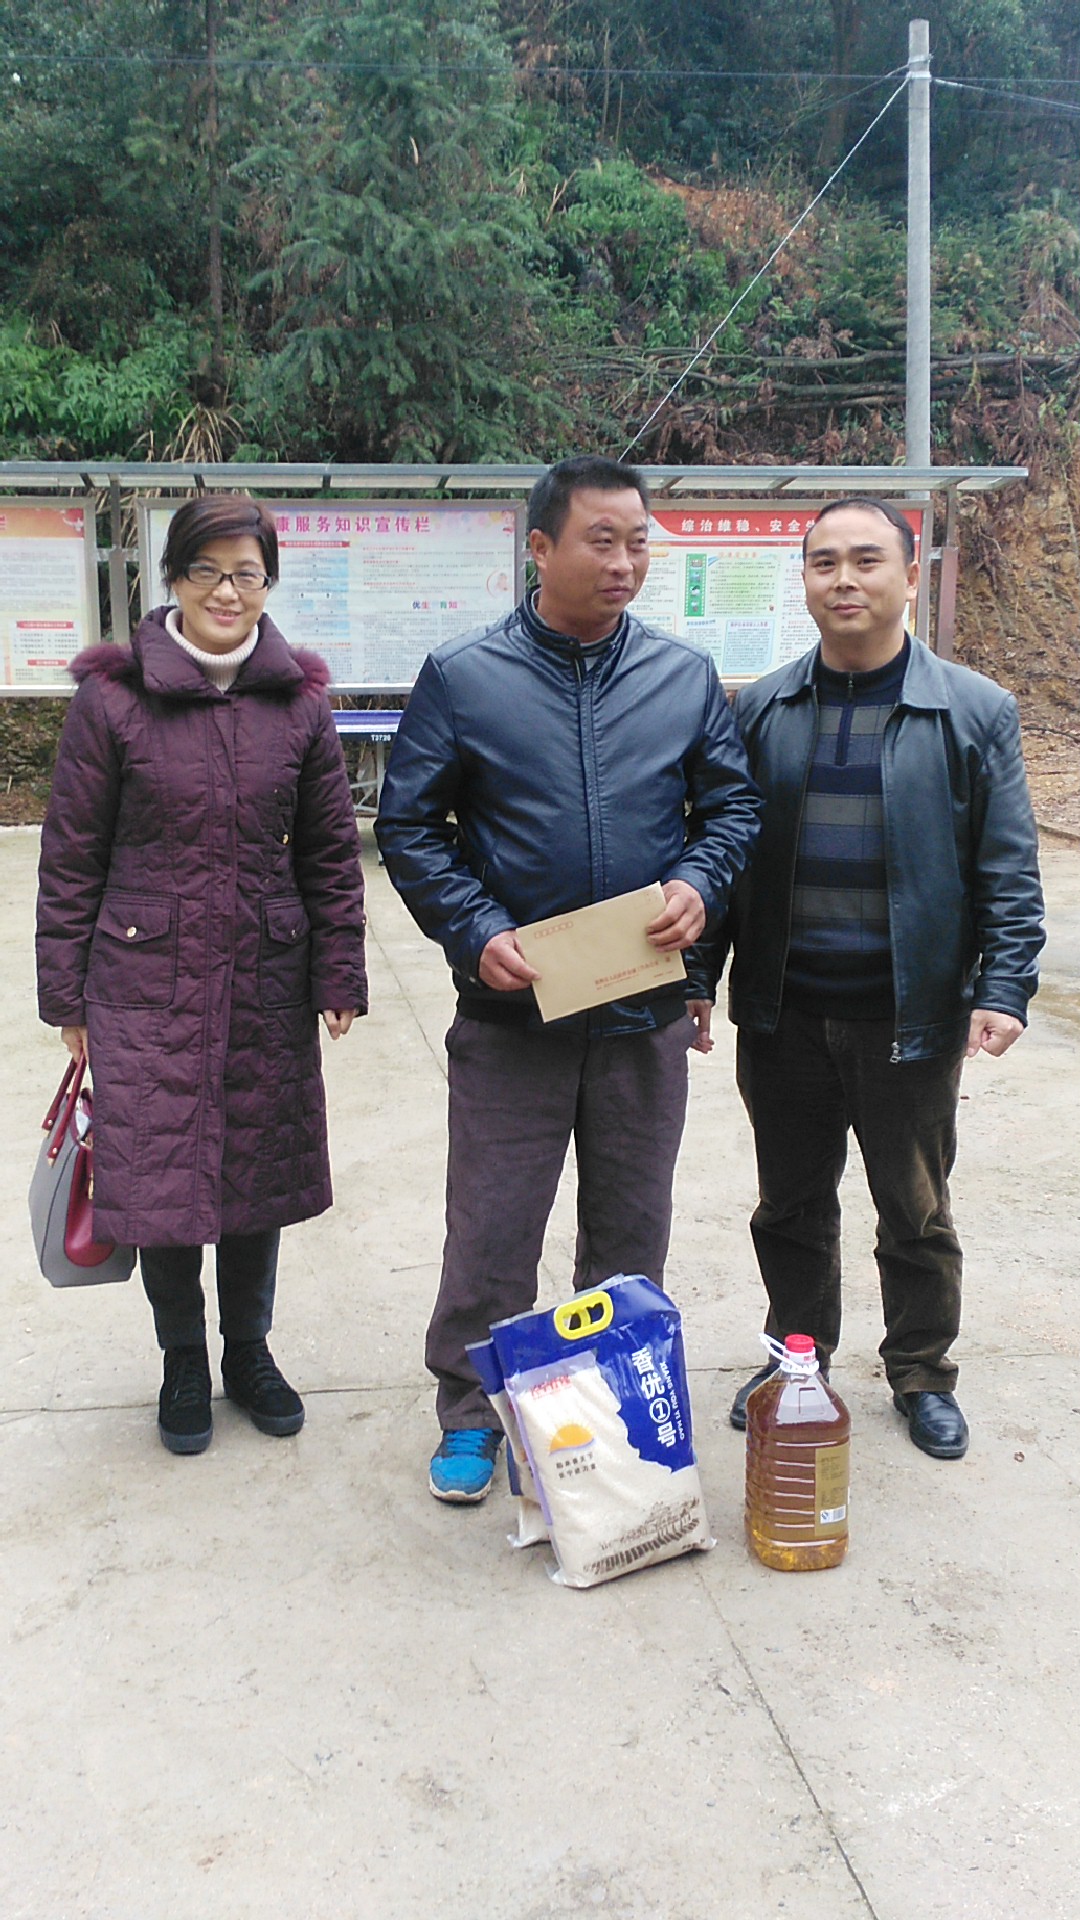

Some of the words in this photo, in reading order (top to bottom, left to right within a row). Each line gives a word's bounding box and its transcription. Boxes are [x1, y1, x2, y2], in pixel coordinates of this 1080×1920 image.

[275, 516, 430, 532] 康服务知识宣传栏
[660, 1360, 674, 1390] XIANG
[669, 1389, 679, 1409] YOU
